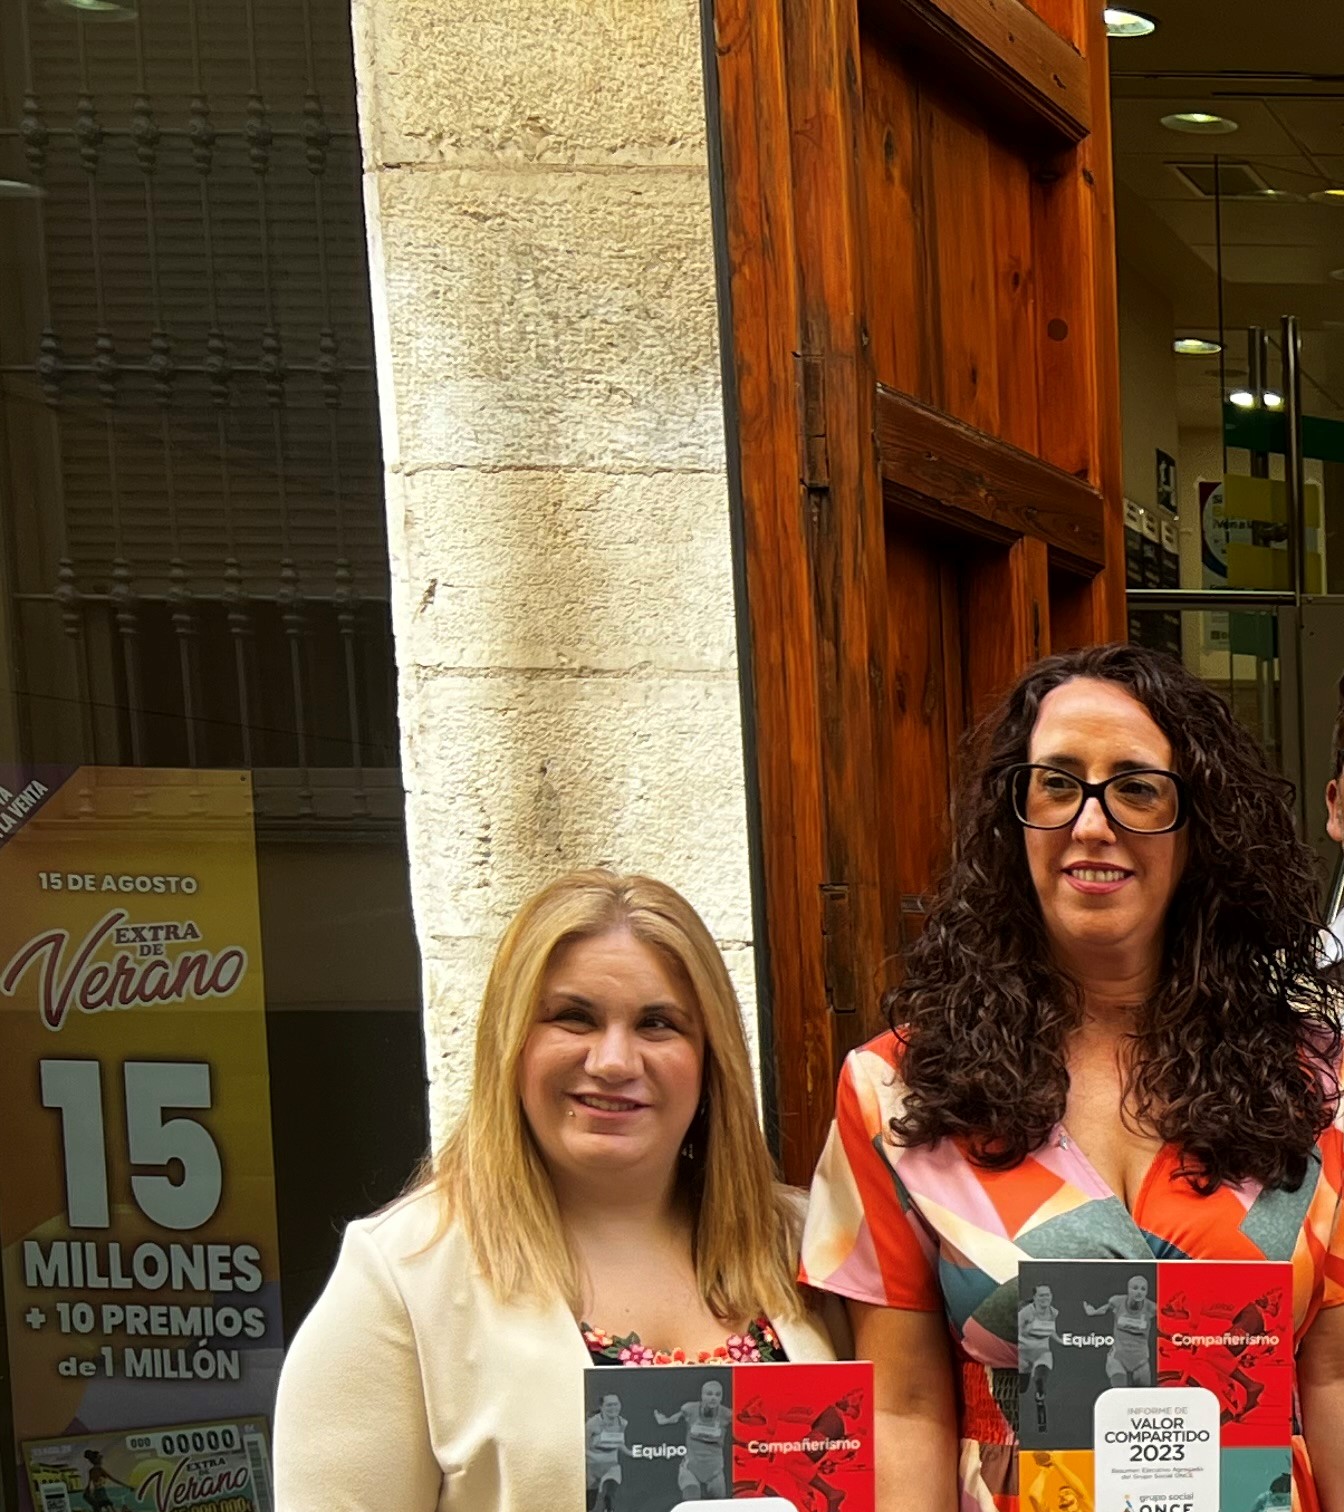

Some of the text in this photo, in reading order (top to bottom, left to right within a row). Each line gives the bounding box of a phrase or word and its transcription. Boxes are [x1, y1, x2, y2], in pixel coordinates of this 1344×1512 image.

[7, 780, 48, 818] VENTA
[39, 872, 197, 894] 15 DE AGOSTO
[114, 922, 200, 945] EXTRA
[140, 943, 163, 957] DE
[3, 911, 243, 1029] Verano
[39, 1059, 222, 1230] 15
[24, 1240, 262, 1292] MILLONES
[25, 1302, 266, 1338] + 10 PREMIOS
[1062, 1333, 1114, 1348] Equipo
[1171, 1332, 1280, 1347] Compañerismo
[58, 1339, 241, 1380] de 1 MILLÓN
[1131, 1417, 1184, 1430] VALOR
[161, 1428, 236, 1456] 00000
[747, 1437, 861, 1455] Compañerismo
[1104, 1430, 1210, 1444] COMPARTIDO
[632, 1443, 687, 1460] Equipo
[1129, 1444, 1185, 1462] 2023
[1139, 1494, 1167, 1503] grupo
